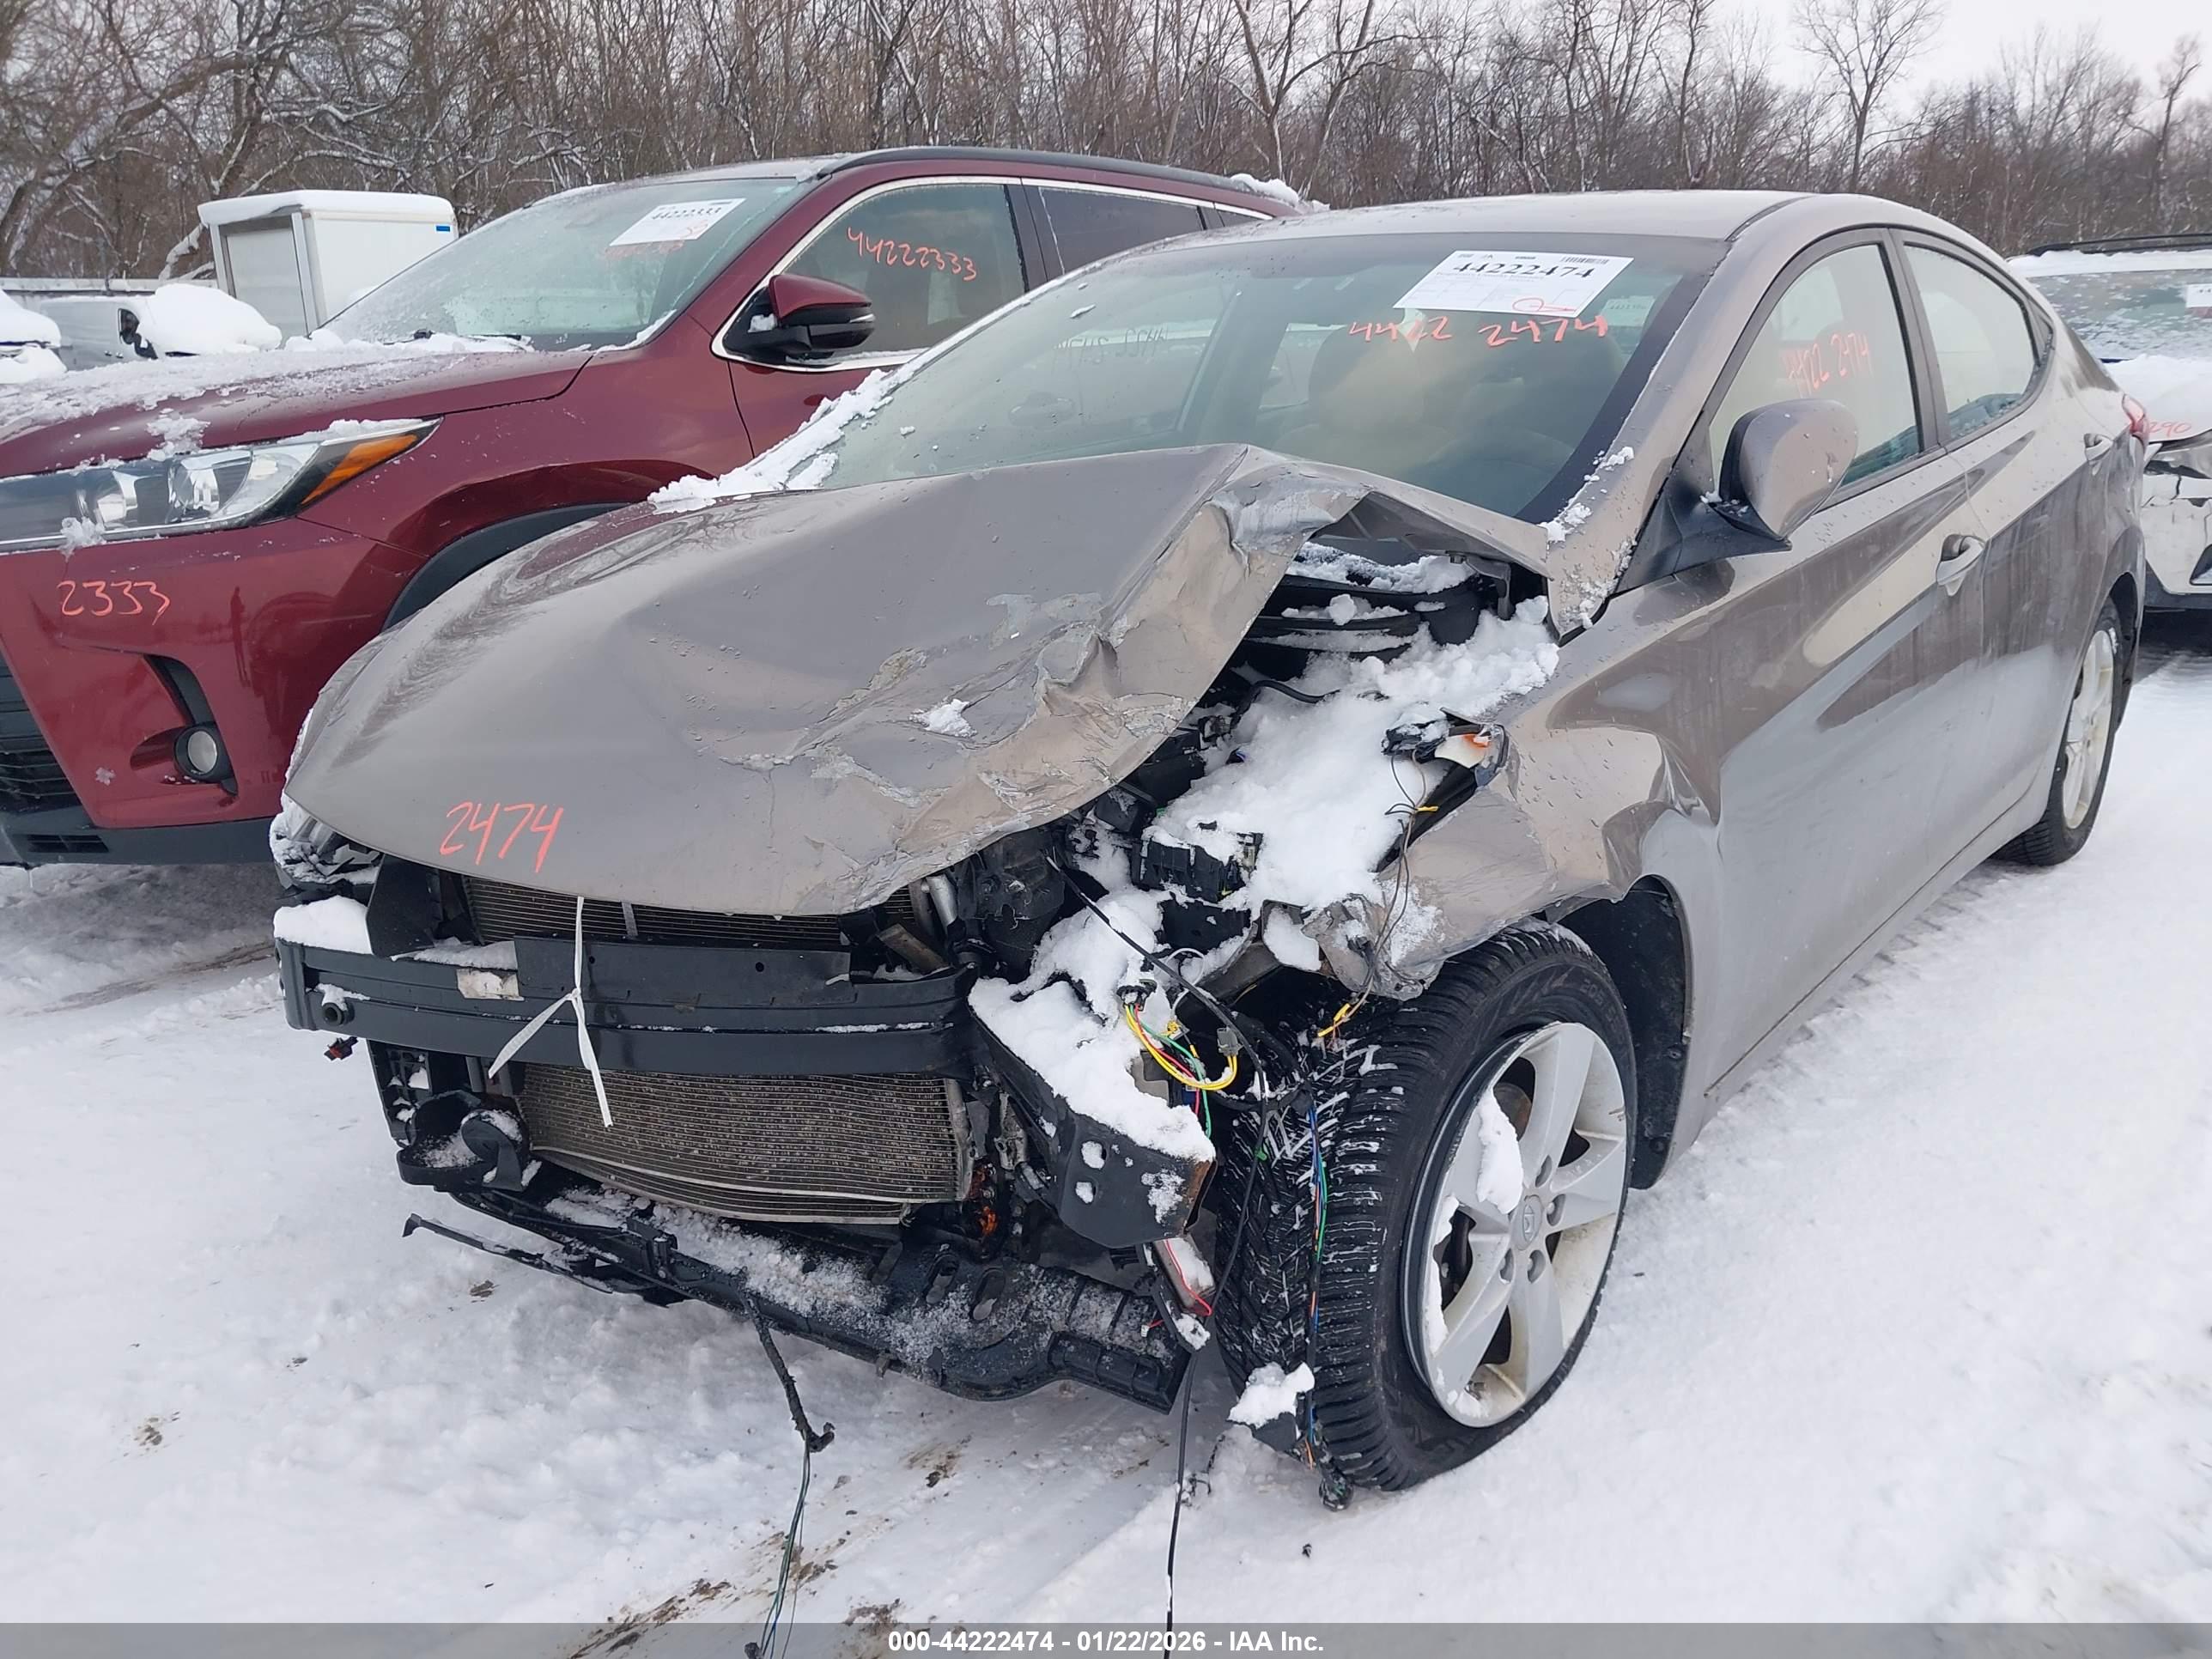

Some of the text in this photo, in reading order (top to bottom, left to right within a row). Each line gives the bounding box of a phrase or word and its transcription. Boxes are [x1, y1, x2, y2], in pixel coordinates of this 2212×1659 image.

[847, 226, 977, 282] 44222333
[1452, 261, 1595, 278] 44222474
[1349, 315, 1608, 347] 4422 2474
[57, 580, 171, 626] 2333
[440, 801, 564, 874] 2474
